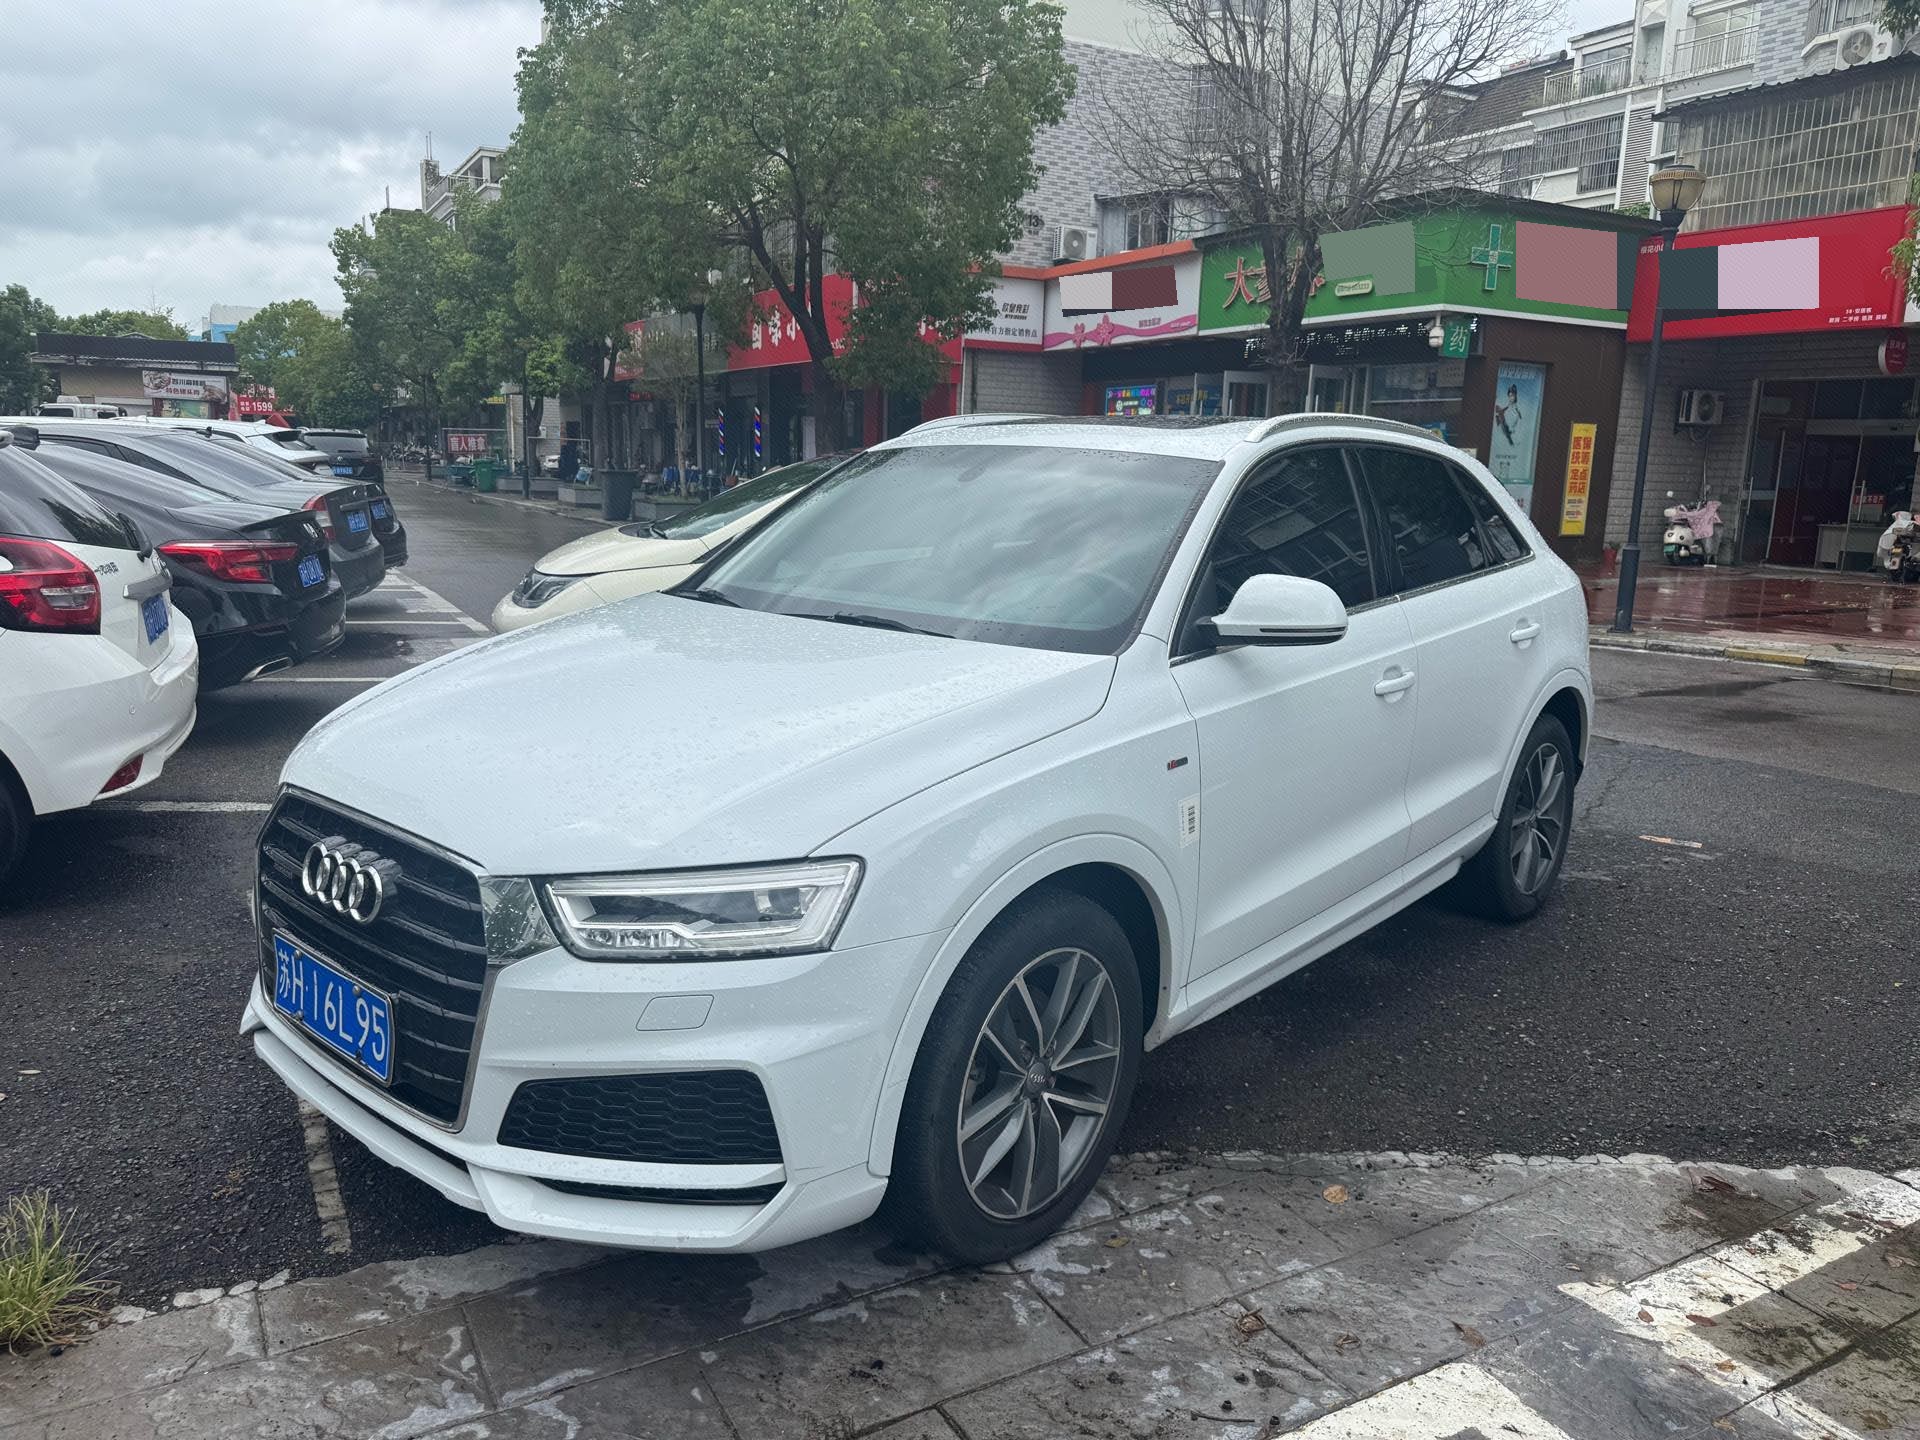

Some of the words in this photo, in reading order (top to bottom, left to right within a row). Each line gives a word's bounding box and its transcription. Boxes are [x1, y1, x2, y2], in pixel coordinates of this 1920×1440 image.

[1449, 325, 1468, 352] 药
[450, 436, 486, 451] 盲人推拿
